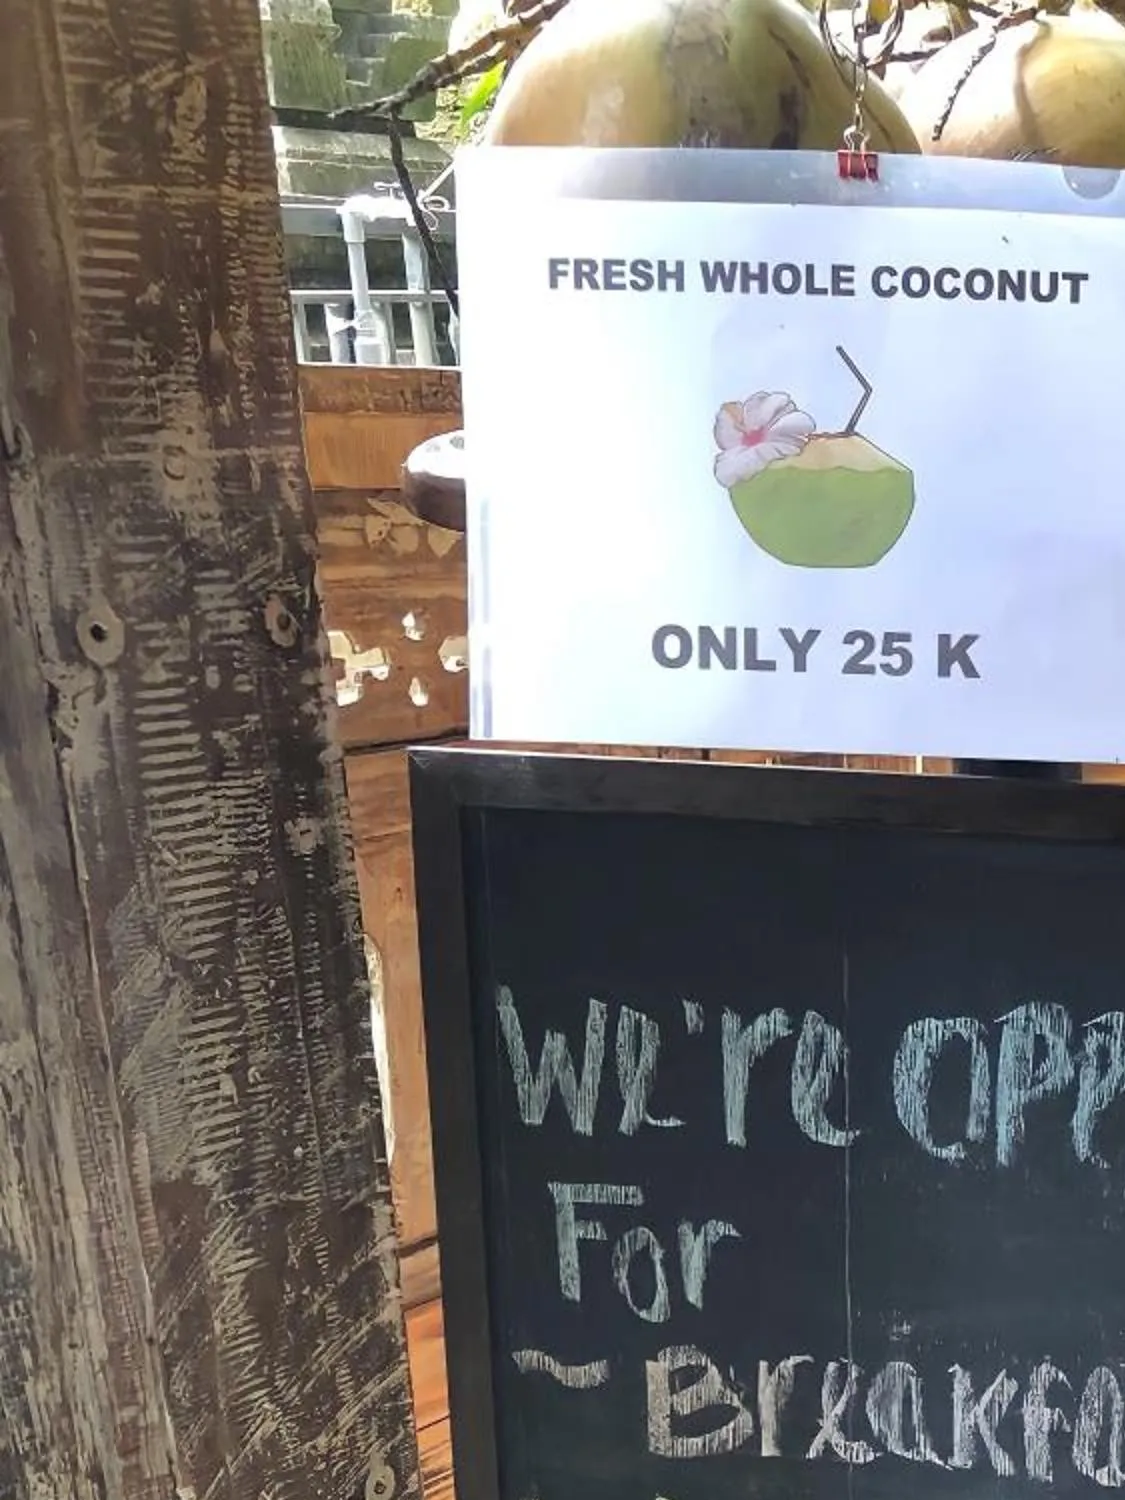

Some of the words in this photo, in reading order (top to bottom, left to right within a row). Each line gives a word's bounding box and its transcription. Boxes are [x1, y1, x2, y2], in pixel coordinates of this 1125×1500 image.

[547, 257, 685, 293] FRESH
[699, 261, 855, 298] WHOLE
[870, 265, 1090, 305] COCONUT
[651, 623, 821, 674] ONLY
[841, 630, 914, 677] 25
[937, 633, 982, 680] K
[496, 984, 860, 1148] We're
[547, 1181, 741, 1323] For
